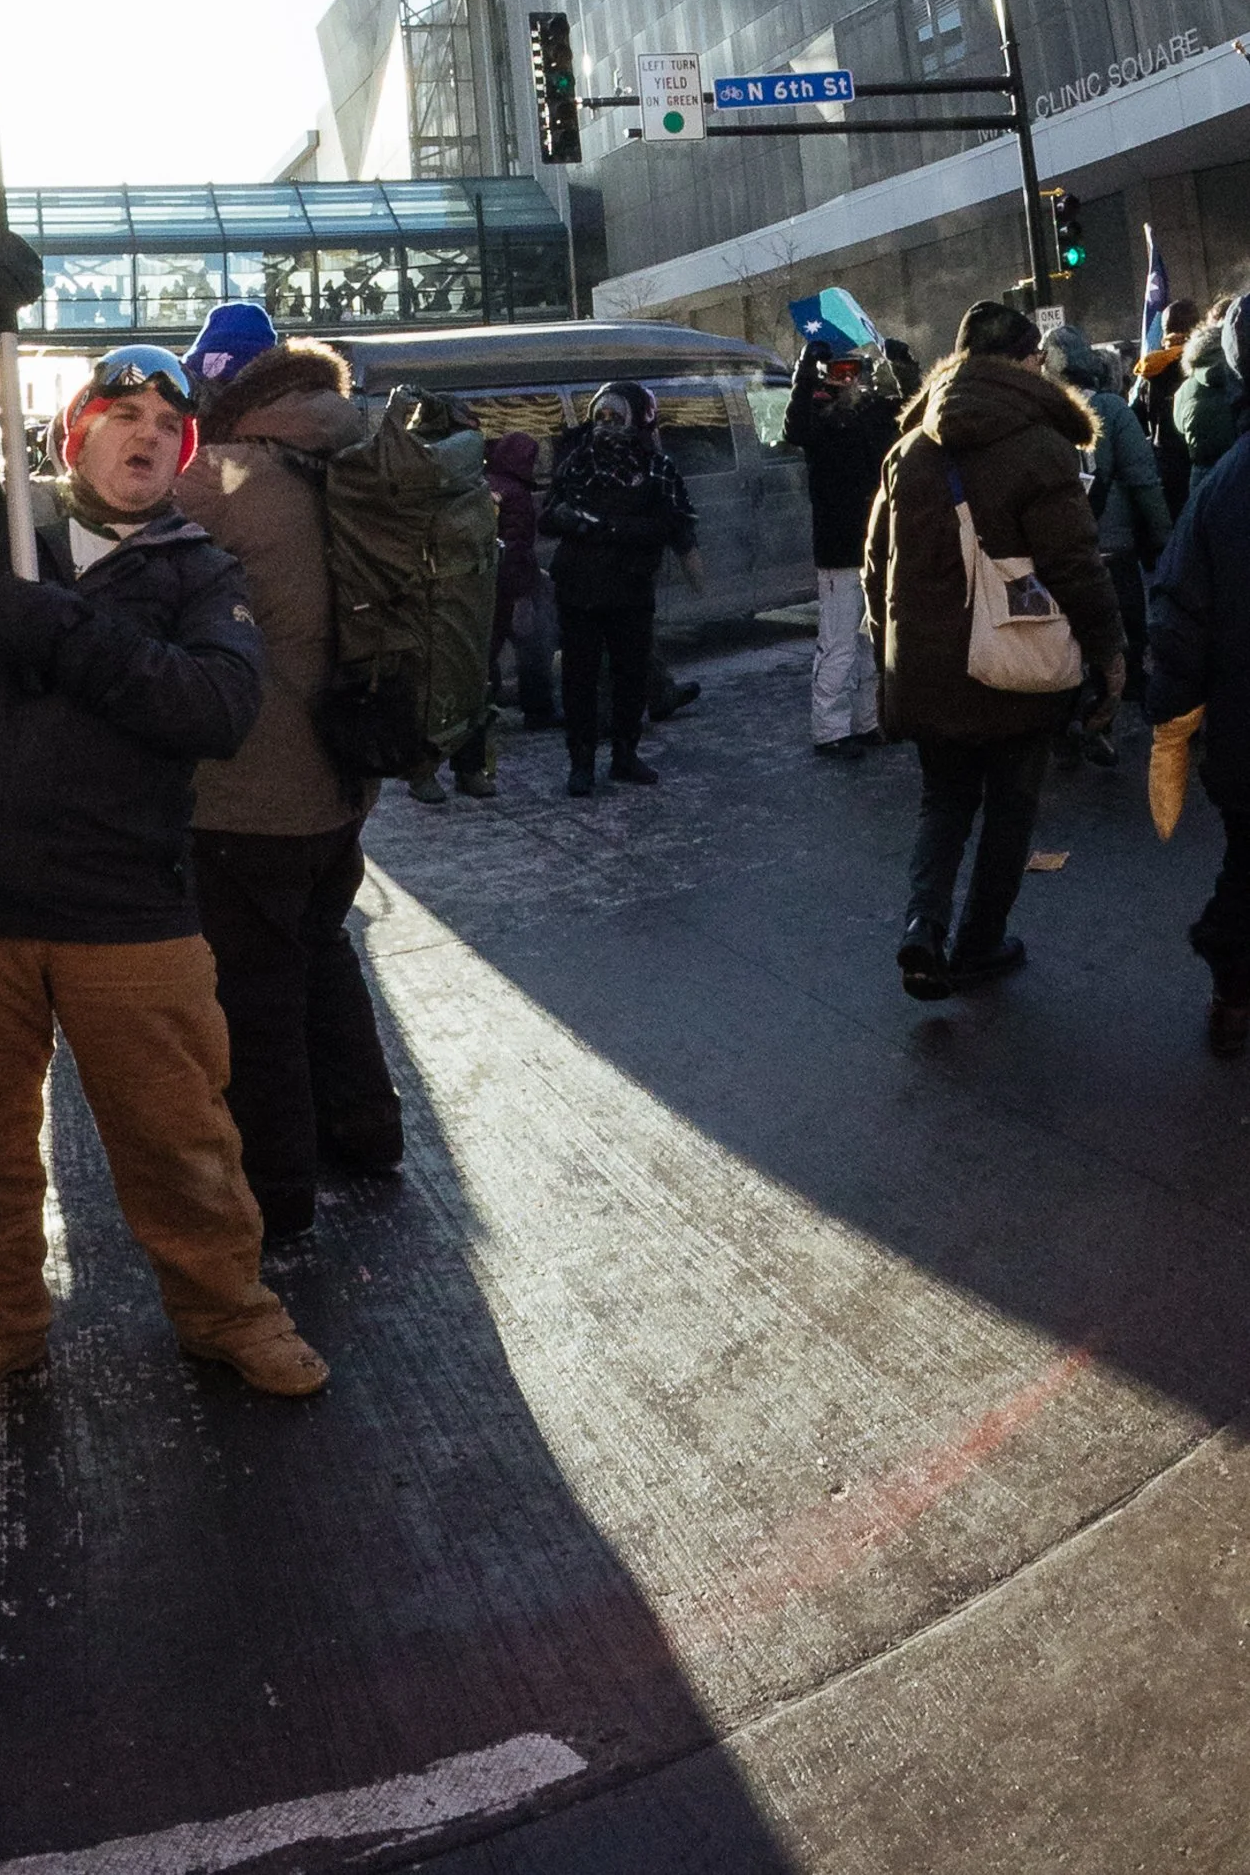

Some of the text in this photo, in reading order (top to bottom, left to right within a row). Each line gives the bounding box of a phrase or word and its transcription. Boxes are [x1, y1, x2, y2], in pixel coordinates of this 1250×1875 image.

[641, 58, 697, 73] LEFT TURN
[1034, 27, 1201, 120] CLINIC SQUARE
[653, 76, 688, 91] YIELD
[747, 76, 849, 102] N 6th St
[645, 93, 699, 107] ON GREEN
[1040, 308, 1061, 322] ONE
